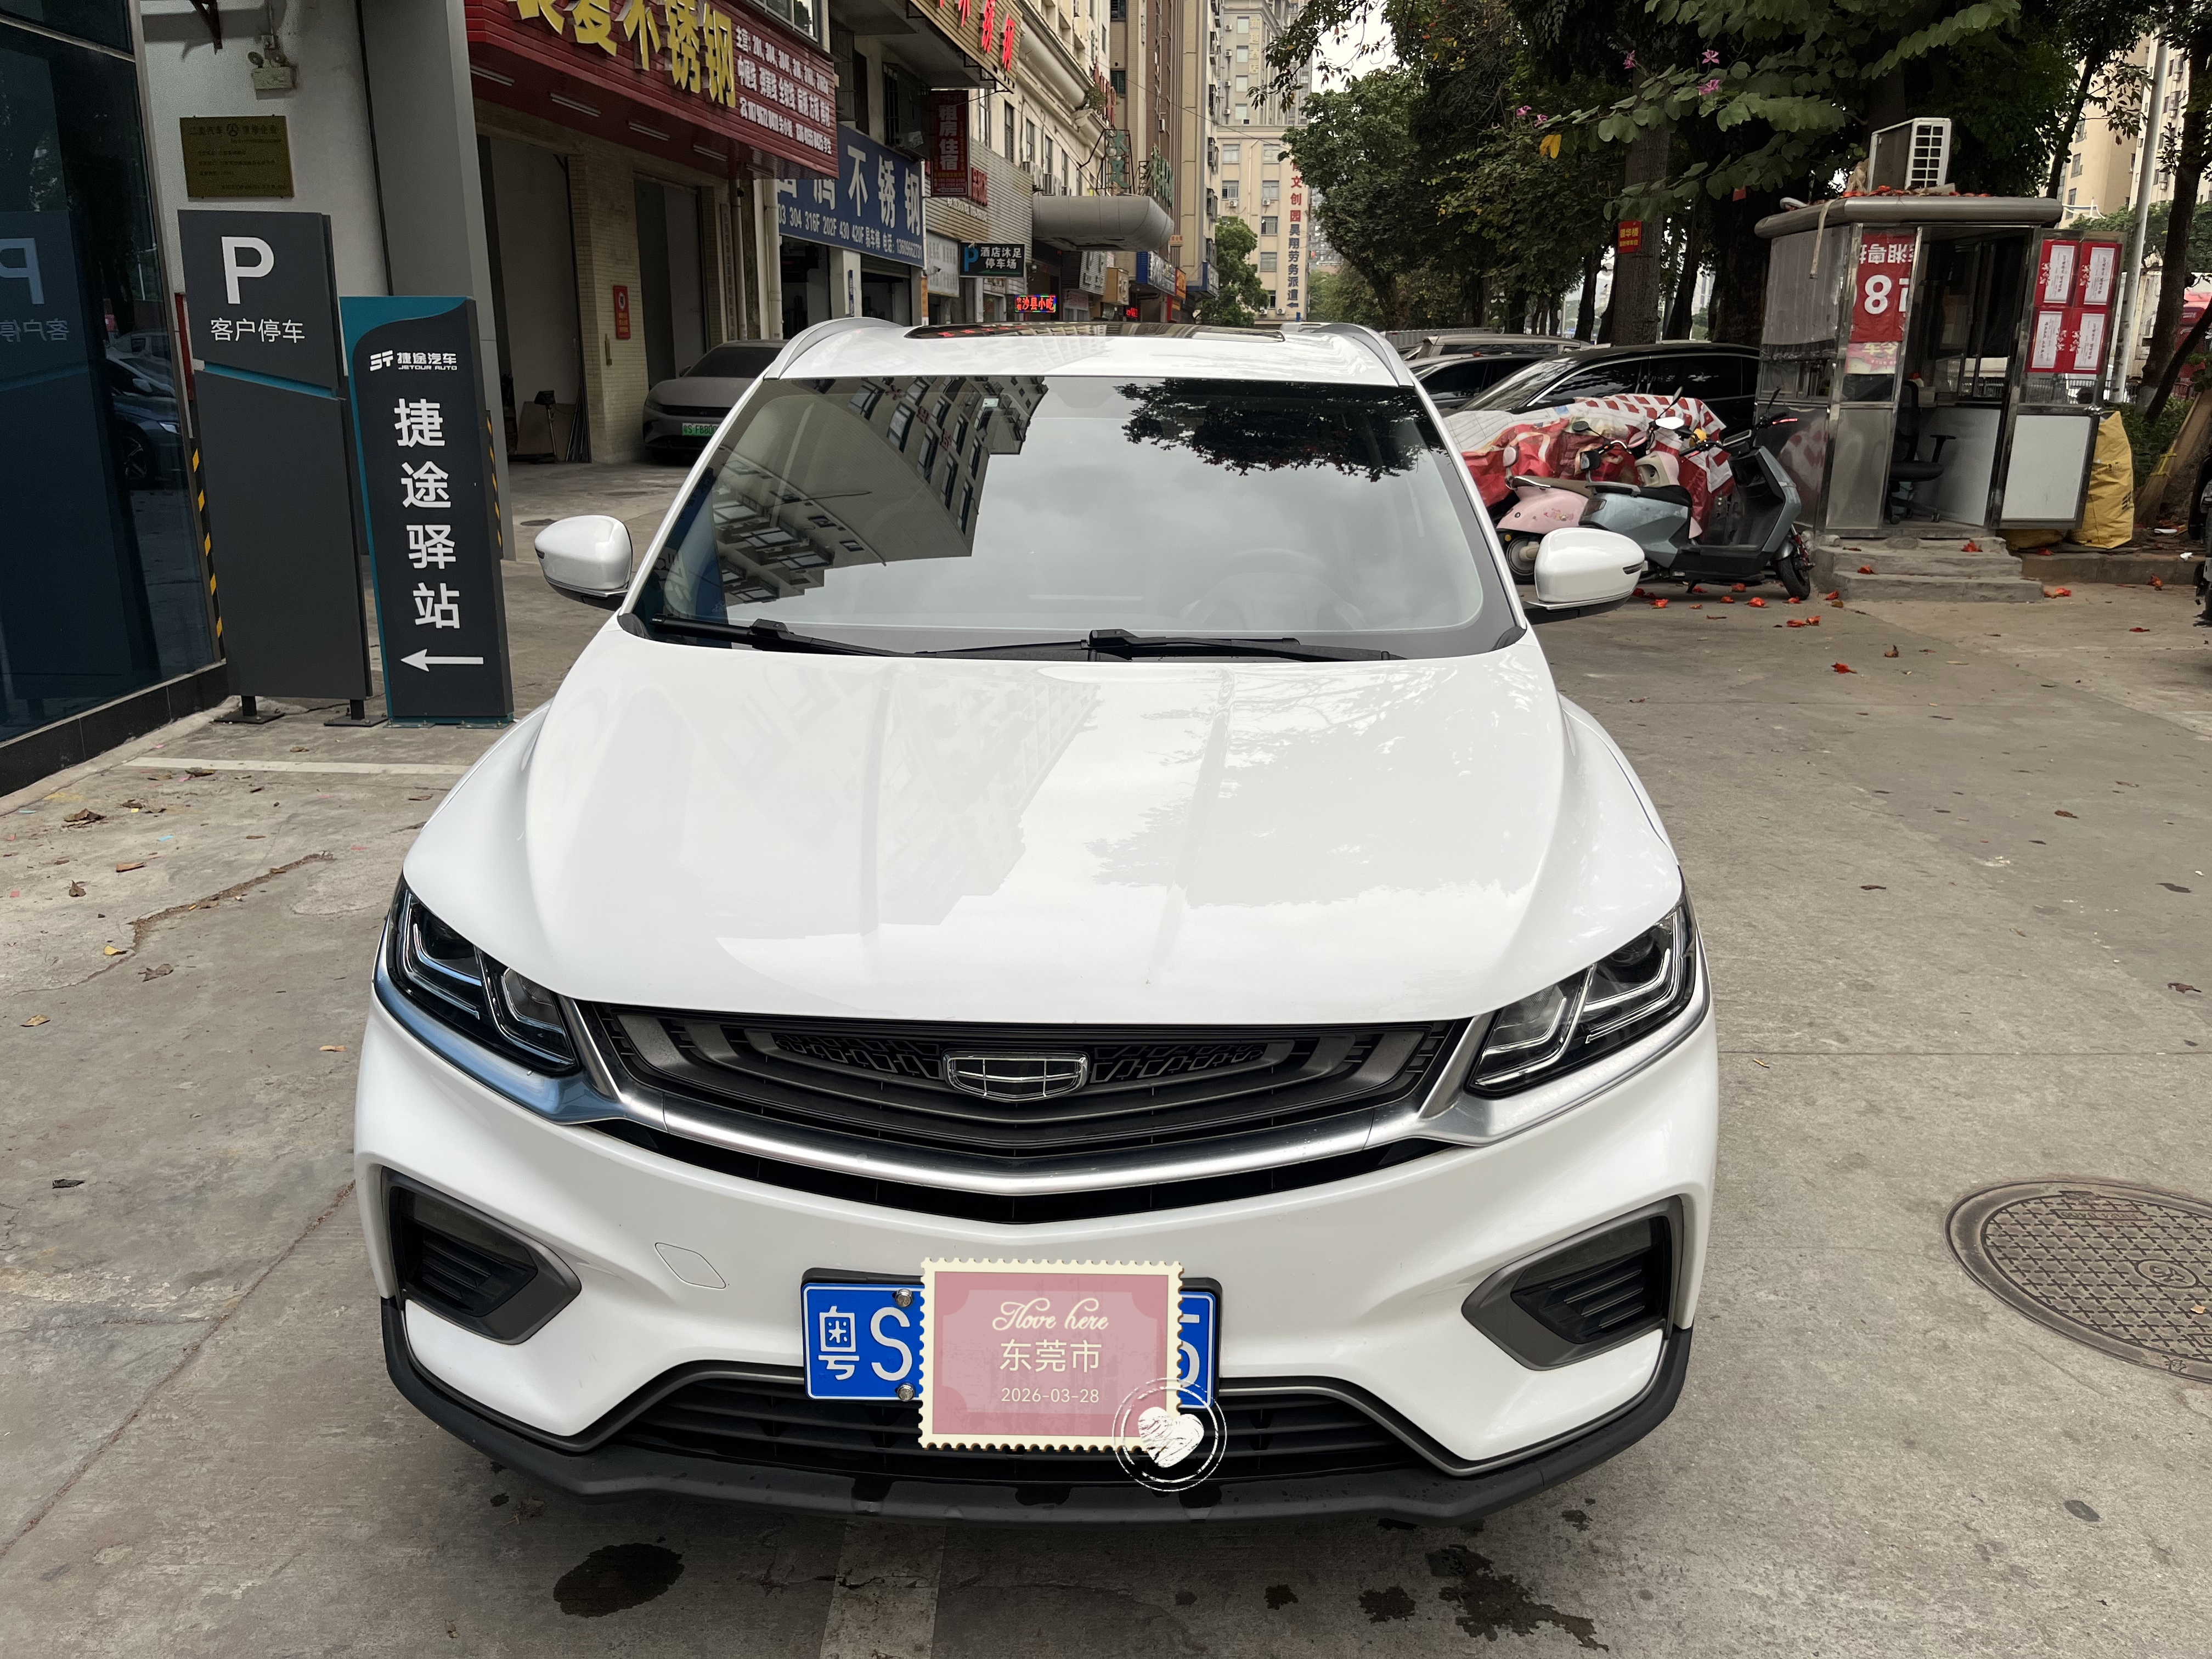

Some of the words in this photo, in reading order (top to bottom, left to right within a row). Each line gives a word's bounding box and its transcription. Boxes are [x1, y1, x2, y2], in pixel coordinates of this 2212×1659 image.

[517, 0, 736, 108] 不锈钢
[939, 104, 959, 171] 租房住宿
[777, 144, 921, 236] 不锈钢
[789, 206, 802, 229] 304
[805, 211, 820, 233] 316F
[823, 216, 837, 237] 202F
[839, 221, 850, 240] 430
[964, 246, 979, 272] P
[980, 246, 1022, 259] 酒店沐足
[985, 258, 1017, 270] 停车场
[221, 236, 274, 304] P
[1022, 296, 1054, 311] 沙县小吃
[211, 317, 305, 344] 客户停车
[397, 352, 457, 364] 捷途汽车
[394, 398, 460, 629] 捷途驿站
[818, 1305, 913, 1382] 粤S
